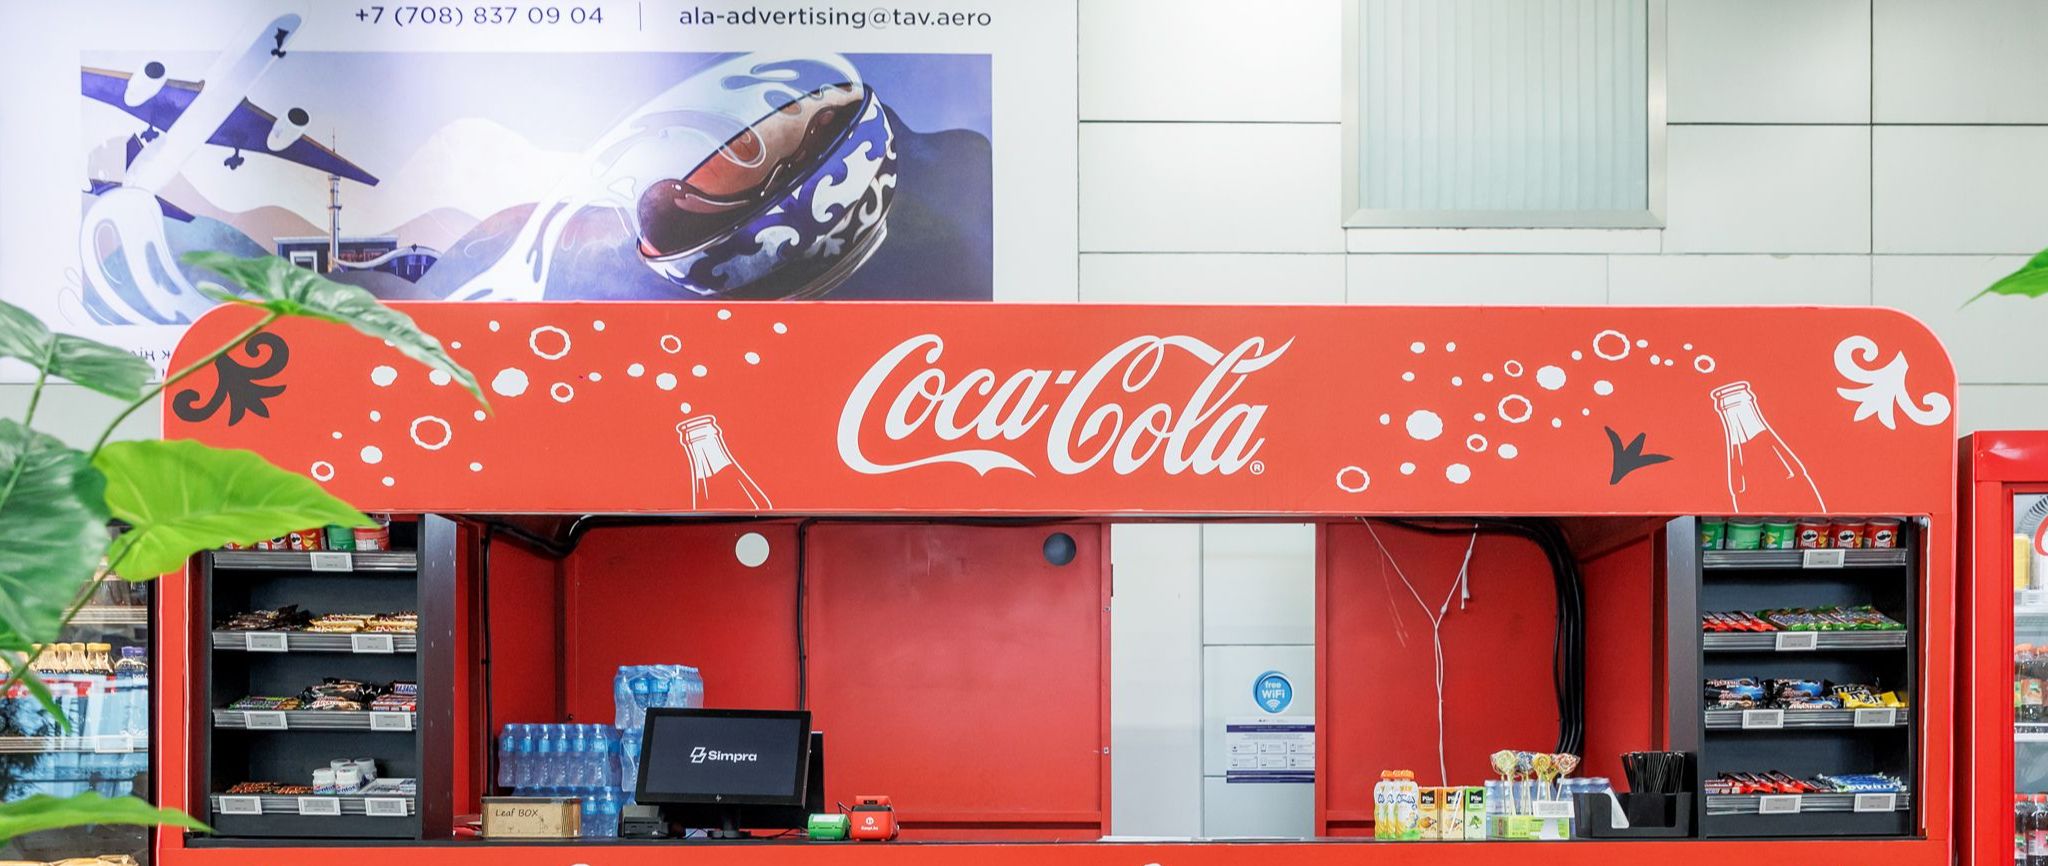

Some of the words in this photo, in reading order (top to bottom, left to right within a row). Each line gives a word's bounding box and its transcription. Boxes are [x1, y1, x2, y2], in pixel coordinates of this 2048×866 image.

[355, 6, 384, 24] +7
[394, 6, 464, 27] (708)
[474, 6, 518, 24] 837
[528, 7, 560, 24] 09
[570, 7, 604, 24] 04
[679, 7, 992, 29] ala-advertising@tav.aero
[1265, 681, 1282, 689] free
[1261, 689, 1286, 699] WiFi
[707, 750, 758, 763] Simpra
[495, 807, 516, 817] Leaf
[518, 808, 539, 817] BOX
